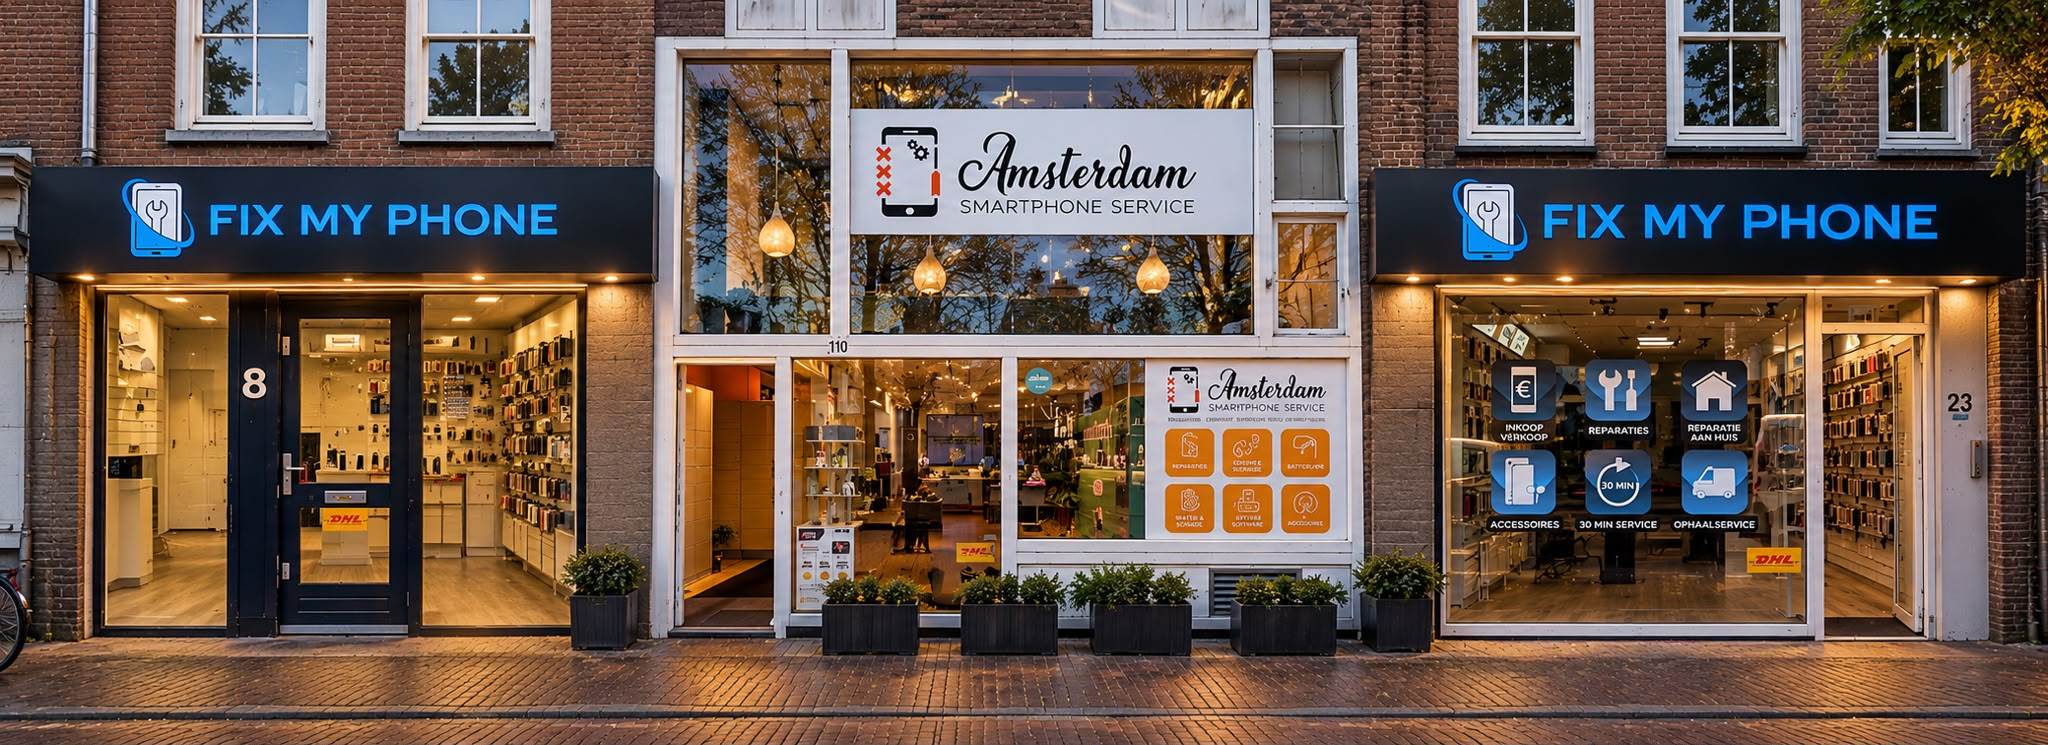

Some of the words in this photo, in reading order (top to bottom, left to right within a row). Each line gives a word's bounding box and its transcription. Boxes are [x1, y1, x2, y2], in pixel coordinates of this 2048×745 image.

[958, 131, 1197, 197] Amsterdam
[960, 198, 1103, 214] SMARTPHONE
[1111, 198, 1195, 214] SERVICE
[209, 203, 284, 236] FIX
[301, 203, 373, 236] MY
[387, 203, 558, 236] PHONE
[1543, 203, 1625, 239] FIX
[1644, 203, 1726, 240] MY
[1743, 203, 1938, 241] PHONE
[828, 340, 848, 355] 110
[242, 367, 267, 399] 8
[1207, 368, 1327, 401] Amsterdam
[1947, 392, 1973, 413] 23
[1284, 403, 1326, 412] SERVICE
[1505, 423, 1544, 432] INKOOP
[1588, 426, 1649, 435] REPARATIES
[1687, 423, 1741, 432] REPARATIE
[1690, 433, 1712, 442] AAN
[1714, 433, 1738, 442] HUIS
[1615, 481, 1634, 490] MIN
[330, 514, 362, 523] DHL
[1490, 520, 1560, 529] ACCESSOIRES
[1579, 520, 1593, 529] 30
[1594, 520, 1613, 529] MIN
[1615, 520, 1658, 529] SERVICE
[1673, 520, 1756, 529] OPHAALSERVICE
[1755, 554, 1794, 565] DHL
